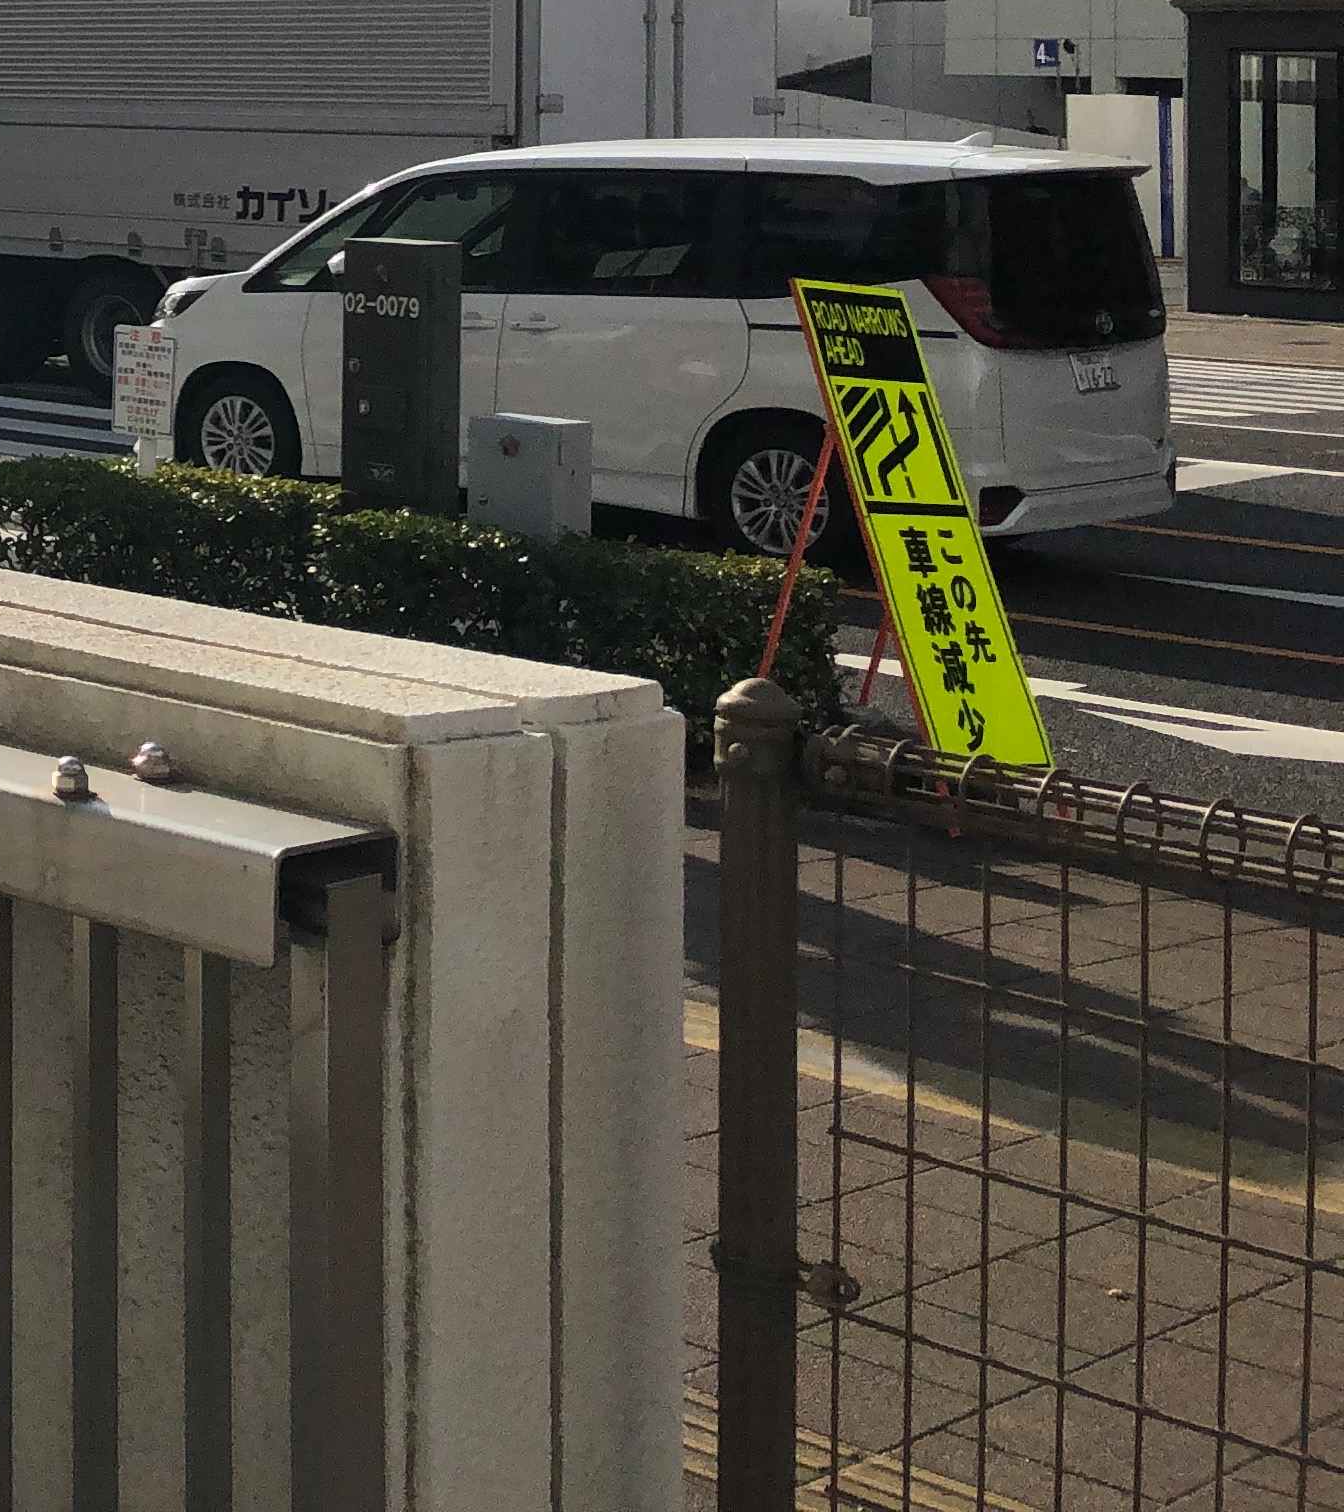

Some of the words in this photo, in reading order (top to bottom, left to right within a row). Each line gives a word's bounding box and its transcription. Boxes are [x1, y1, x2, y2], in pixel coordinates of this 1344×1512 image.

[173, 191, 231, 210] 株式会社
[344, 292, 420, 319] 02-0079
[811, 299, 848, 332] ROAD
[845, 303, 908, 338] NARROWS
[823, 334, 865, 367] AHEAD
[937, 528, 998, 664] この先
[898, 525, 986, 753] 車線減少
